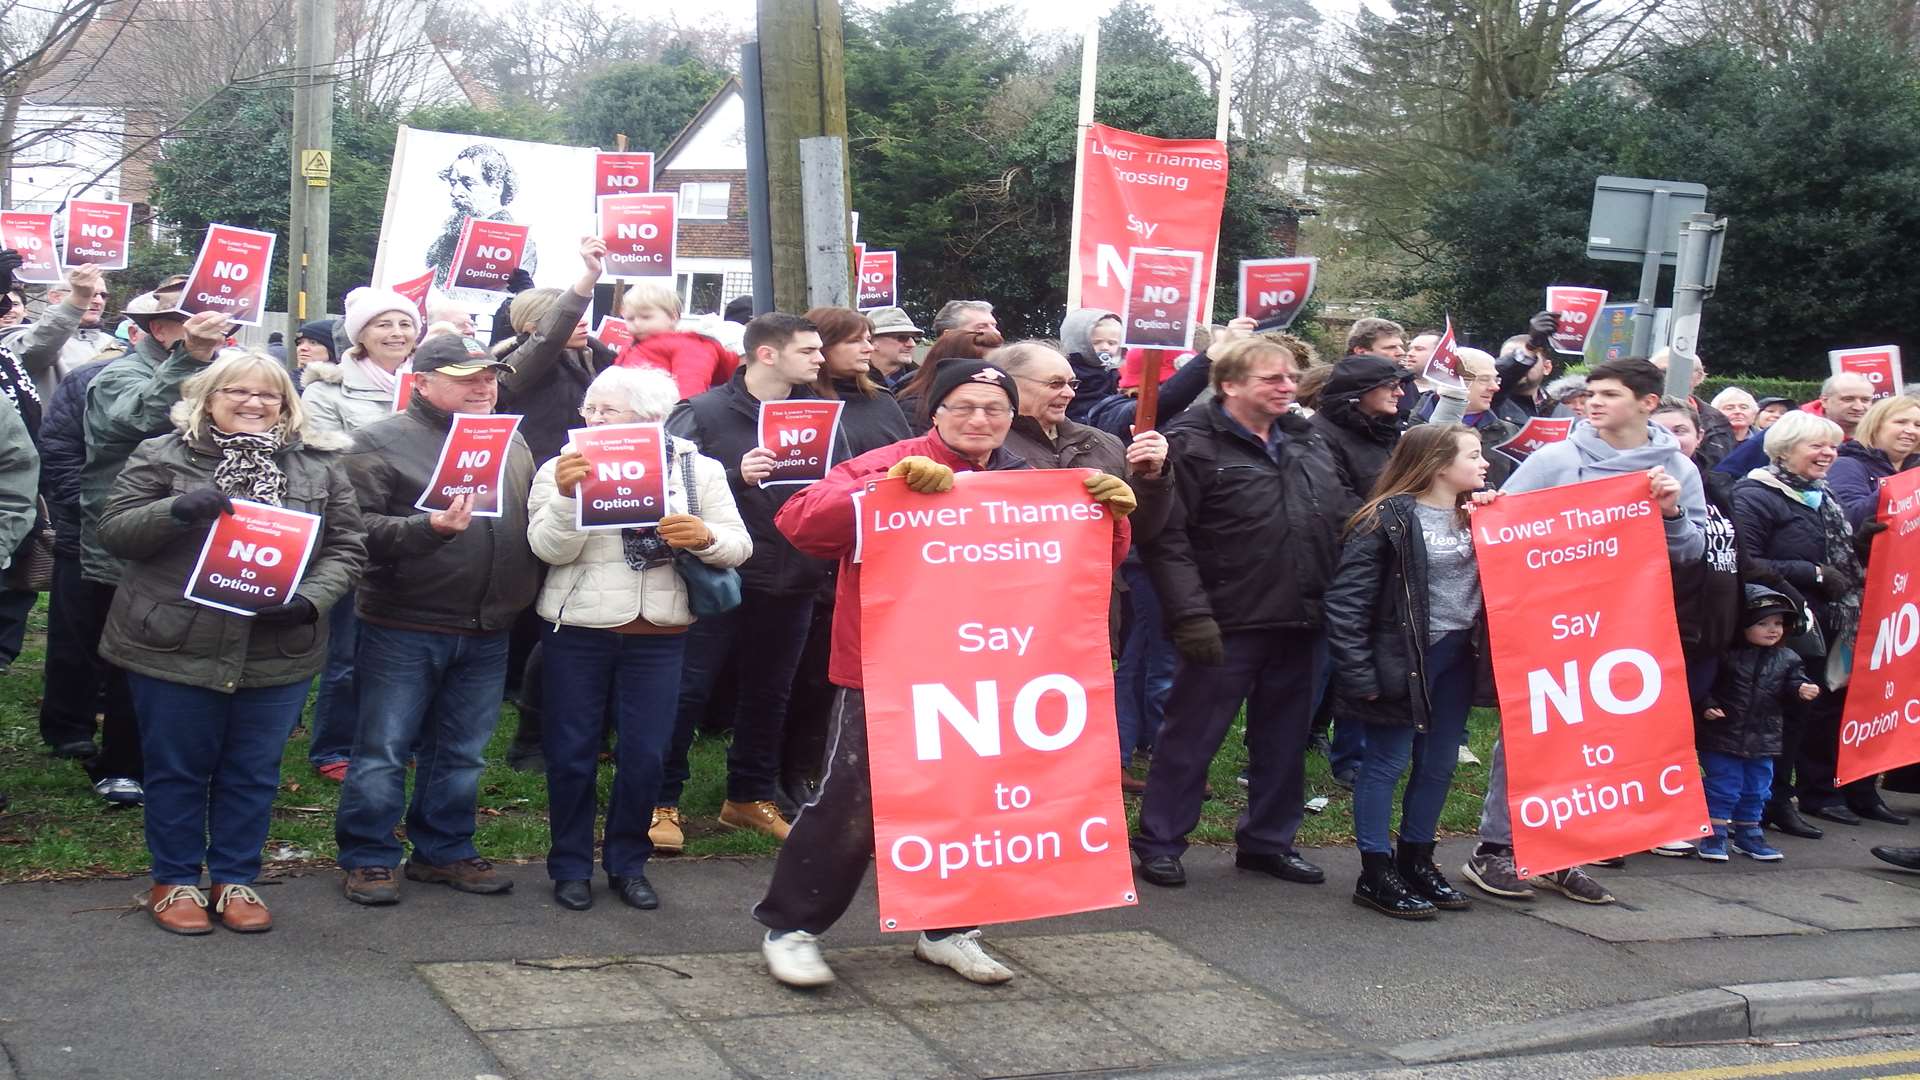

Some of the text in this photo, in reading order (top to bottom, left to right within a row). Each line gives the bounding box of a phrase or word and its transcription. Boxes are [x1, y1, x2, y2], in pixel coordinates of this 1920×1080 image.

[1145, 151, 1223, 171] Thames
[607, 174, 639, 188] NO
[81, 223, 114, 239] NO
[617, 223, 659, 240] NO
[1126, 213, 1158, 239] Say
[14, 236, 42, 250] NO
[632, 243, 645, 252] to
[74, 247, 117, 258] Option C
[476, 244, 512, 261] NO
[611, 253, 663, 264] Option C
[22, 262, 52, 270] ption C
[213, 260, 249, 281] NO
[465, 268, 499, 280] Option
[485, 262, 497, 270] to
[1097, 244, 1130, 290] N
[861, 272, 884, 284] NO
[221, 284, 232, 294] to
[861, 291, 881, 300] ption
[1143, 285, 1180, 304] NO
[1259, 289, 1296, 307] NO
[197, 292, 249, 307] Option C
[1154, 308, 1167, 318] to
[1560, 310, 1588, 324] NO
[1134, 319, 1182, 330] Option C
[1449, 368, 1455, 376] C
[779, 428, 818, 447] NO
[456, 449, 491, 469] NO
[790, 448, 801, 456] to
[808, 456, 818, 465] C
[463, 473, 473, 483] to
[597, 460, 646, 482] NO
[442, 484, 488, 497] Option C
[617, 486, 632, 496] to
[592, 495, 655, 511] Option C
[873, 499, 1104, 532] Lower Thames
[1480, 515, 1556, 546] Lower
[1561, 501, 1651, 531] Thames
[227, 540, 282, 567] NO
[921, 537, 1062, 565] Crossing
[1526, 535, 1619, 570] Crossing
[241, 567, 257, 580] to
[209, 573, 277, 598] Option C
[1892, 572, 1909, 595] Say
[1551, 611, 1601, 641] Say
[958, 622, 1034, 656] Say
[1869, 602, 1920, 671] NO
[1527, 648, 1662, 735] NO
[1884, 680, 1894, 699] to
[912, 673, 1088, 761] NO
[1842, 699, 1920, 748] Option C
[1582, 743, 1615, 768] to
[995, 783, 1031, 810] to
[1520, 765, 1685, 830] Option C
[890, 817, 1110, 879] Option C
